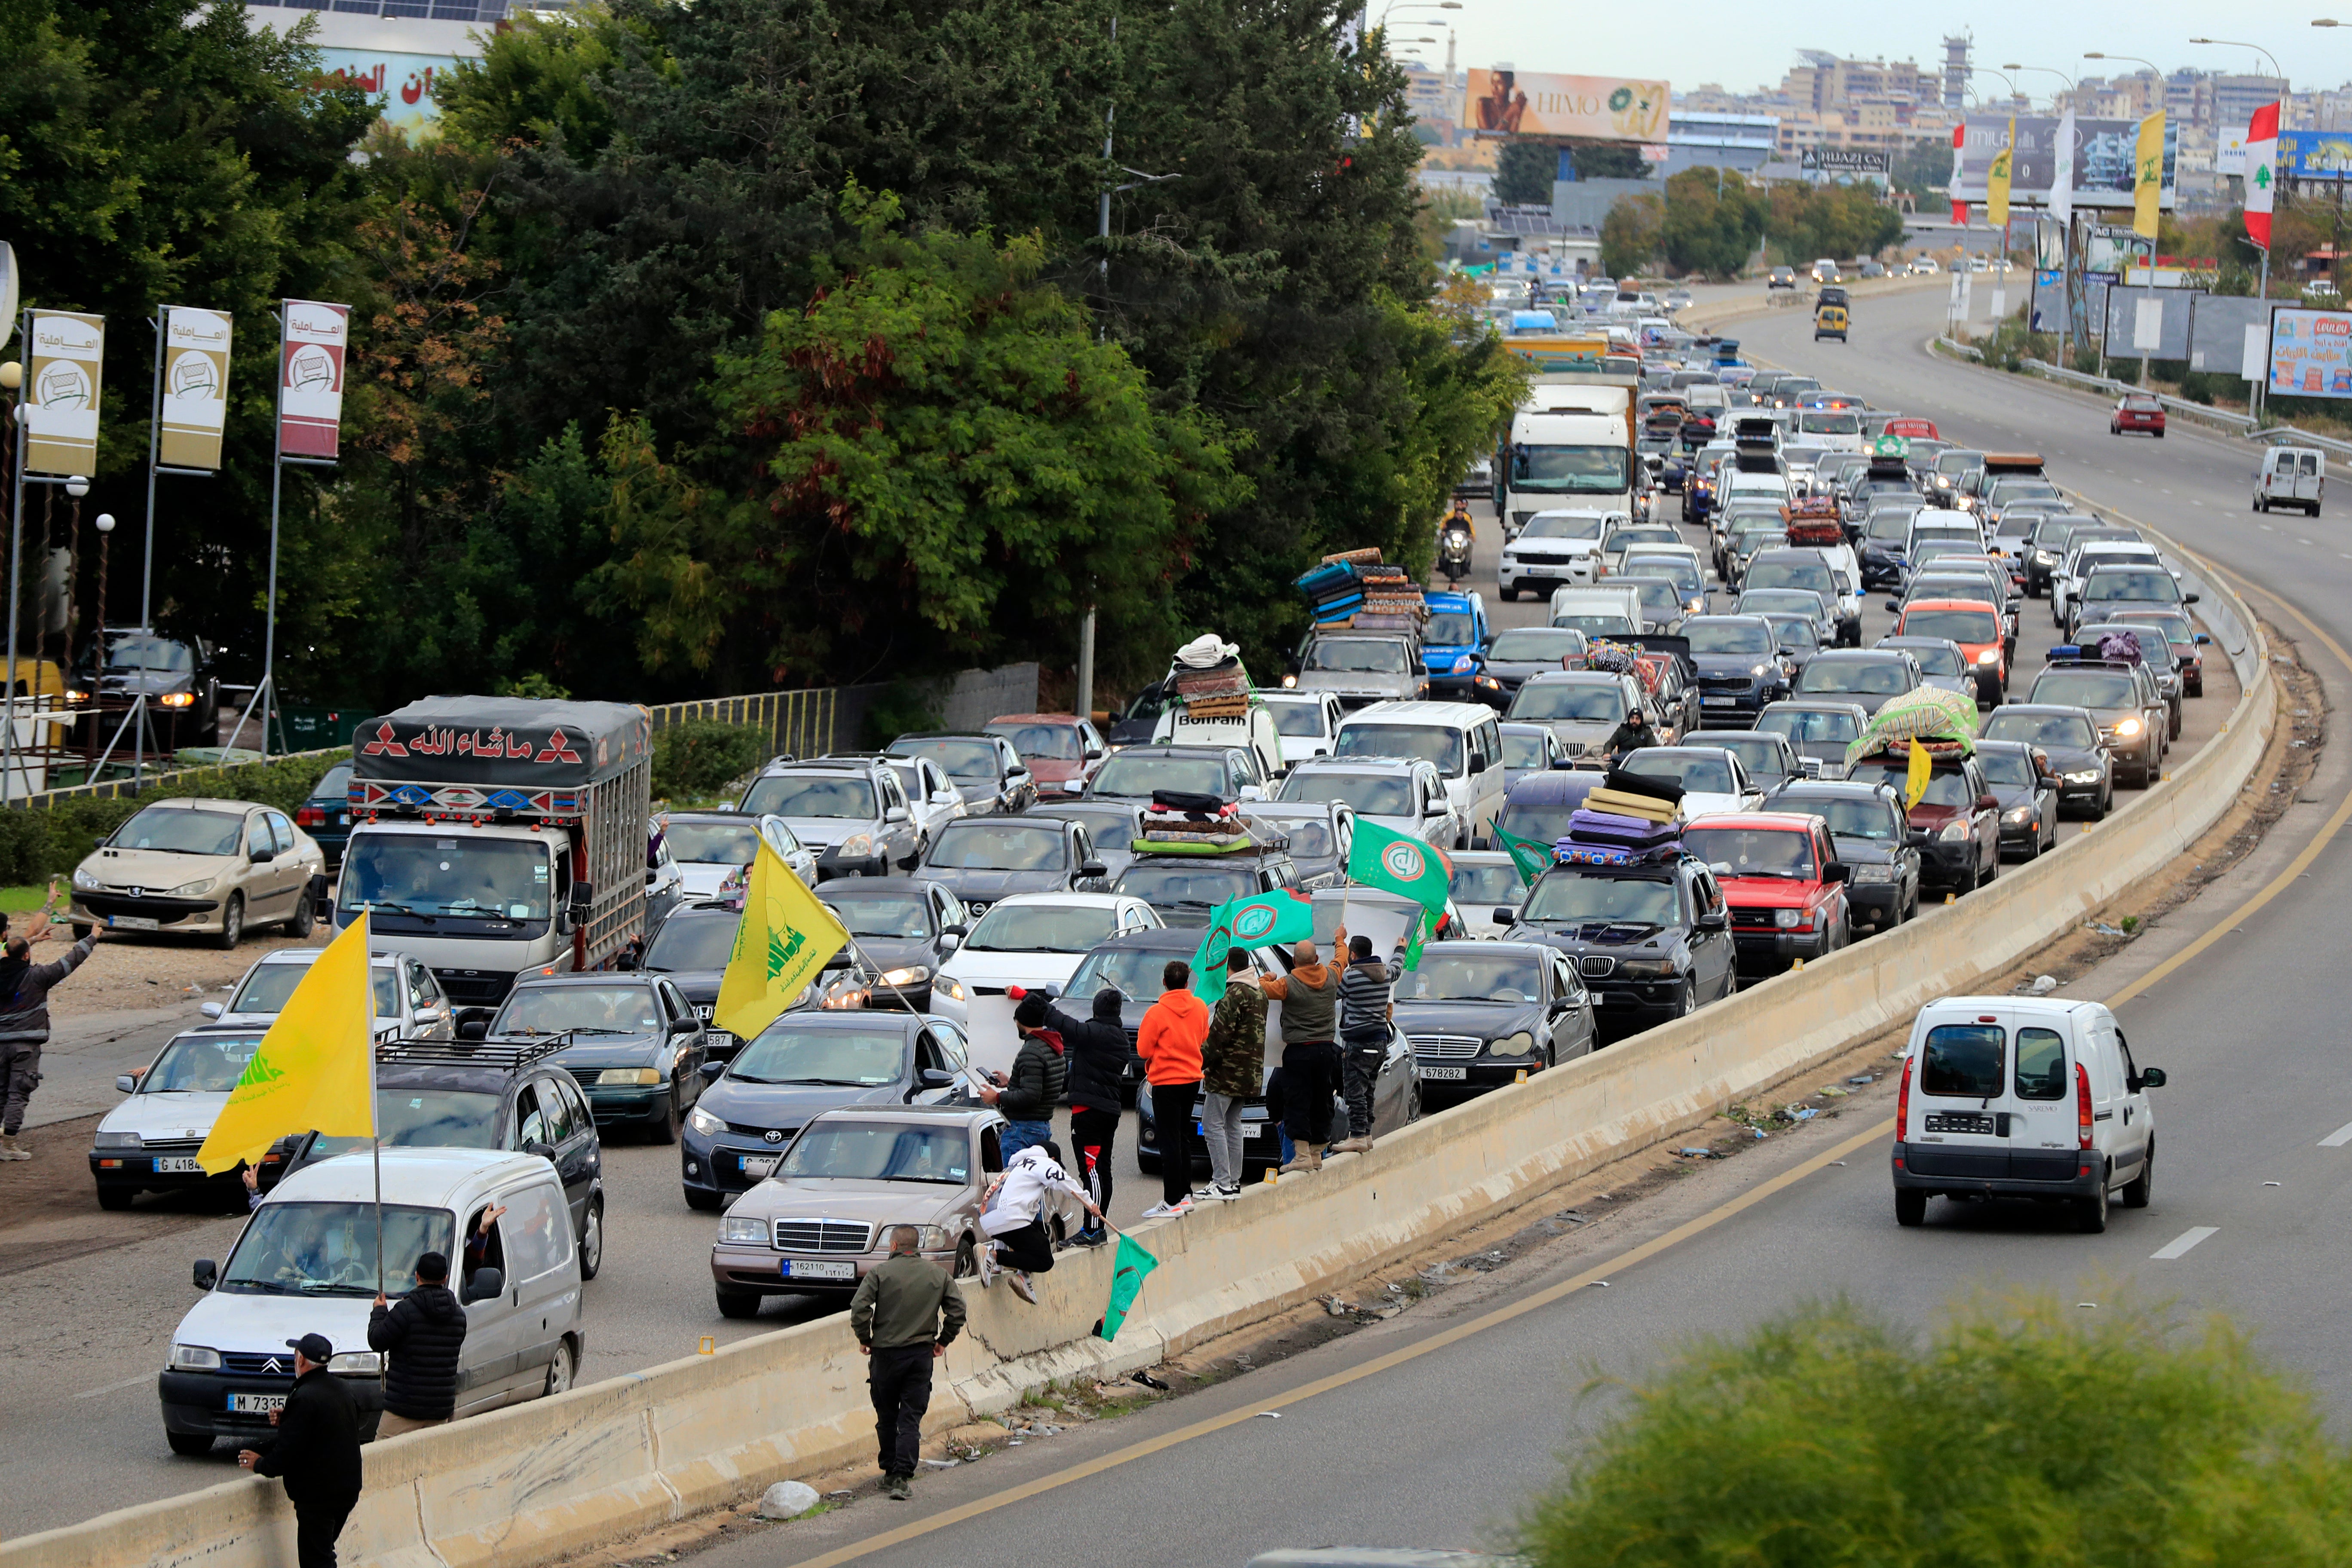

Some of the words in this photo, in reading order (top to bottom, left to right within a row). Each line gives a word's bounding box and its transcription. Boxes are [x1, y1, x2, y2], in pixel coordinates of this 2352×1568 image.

[1537, 93, 1599, 116] HIMO
[173, 325, 227, 340] العاملية
[292, 320, 342, 334] العاملية
[40, 333, 98, 349] العاملية
[409, 724, 454, 756] الله
[709, 1035, 726, 1045] 587
[1426, 1068, 1460, 1078] 678282
[162, 1158, 168, 1170] G
[175, 1159, 204, 1170] 4184
[796, 1262, 824, 1271] 162110
[238, 1396, 245, 1409] M
